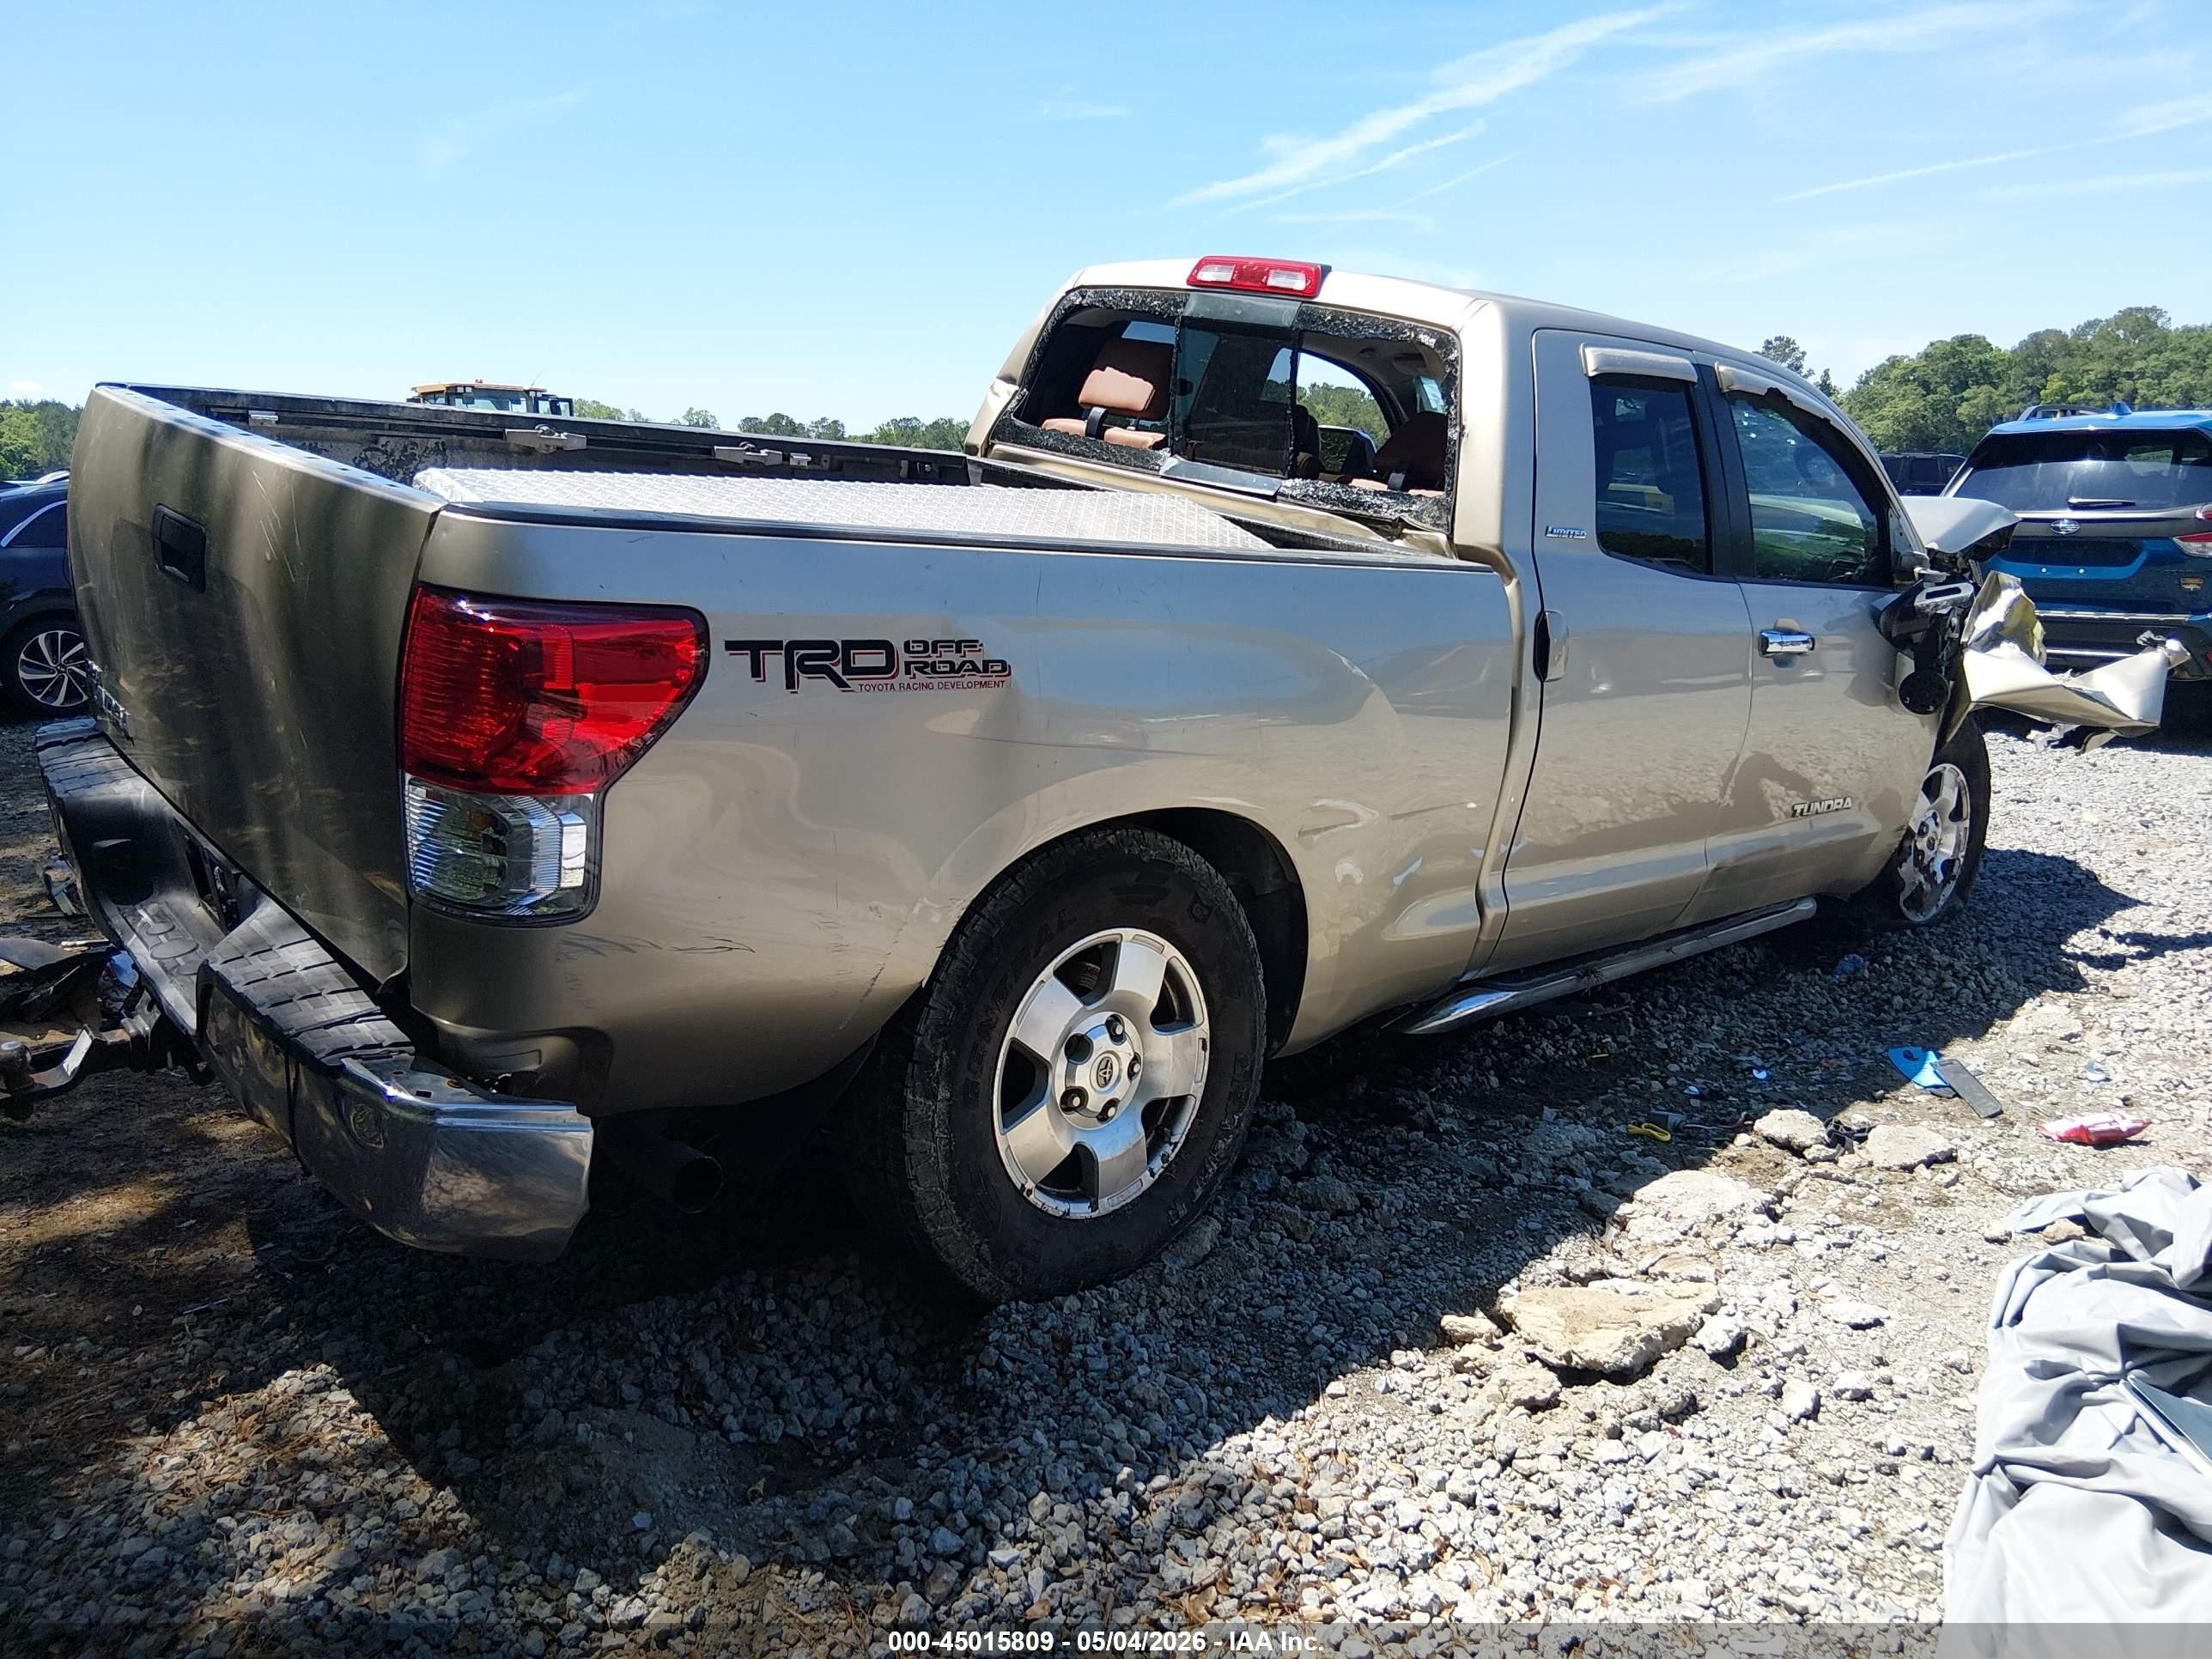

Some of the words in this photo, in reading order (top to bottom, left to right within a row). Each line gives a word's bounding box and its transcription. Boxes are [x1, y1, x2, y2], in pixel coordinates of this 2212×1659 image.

[1545, 526, 1588, 539] LIMITED
[903, 639, 984, 659] OFF
[724, 639, 900, 694] TRD
[903, 659, 1012, 679] ROAD
[858, 683, 896, 693] TOYOTA
[898, 682, 935, 691] RACING
[937, 680, 1006, 691] DEVELOPMENT
[1791, 796, 1853, 818] TUNDRA
